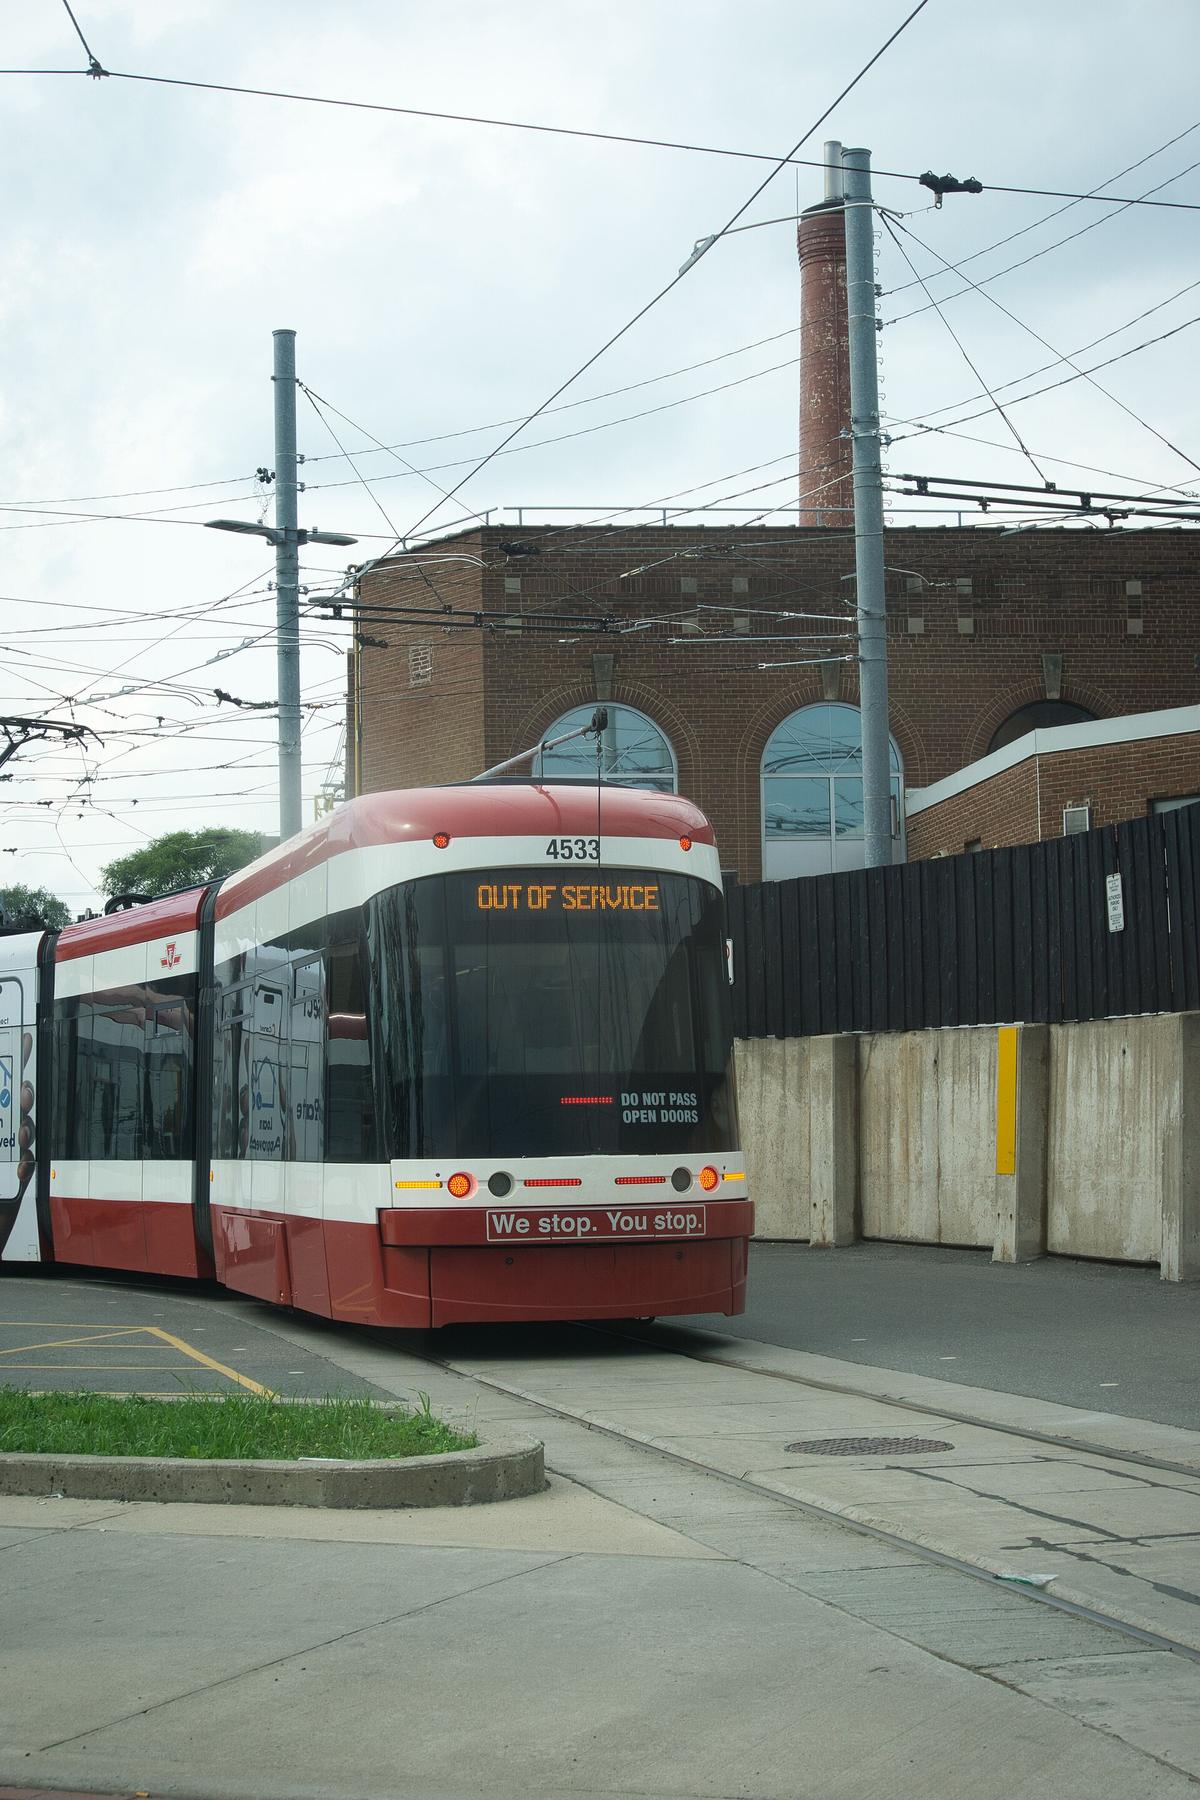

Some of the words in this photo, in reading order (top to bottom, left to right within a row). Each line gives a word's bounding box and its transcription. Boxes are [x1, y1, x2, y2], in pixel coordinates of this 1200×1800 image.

[546, 839, 600, 860] 4533
[478, 885, 522, 910] OUT
[527, 885, 556, 910] OF
[562, 885, 659, 910] SERVICE
[621, 1093, 639, 1106] DO
[642, 1092, 666, 1106] NOT
[669, 1092, 697, 1106] PASS
[622, 1110, 657, 1123] OPEN
[660, 1110, 699, 1123] DOORS
[492, 1214, 530, 1234] We
[538, 1213, 597, 1237] stop.
[606, 1211, 647, 1232] You
[654, 1211, 702, 1234] stop.
